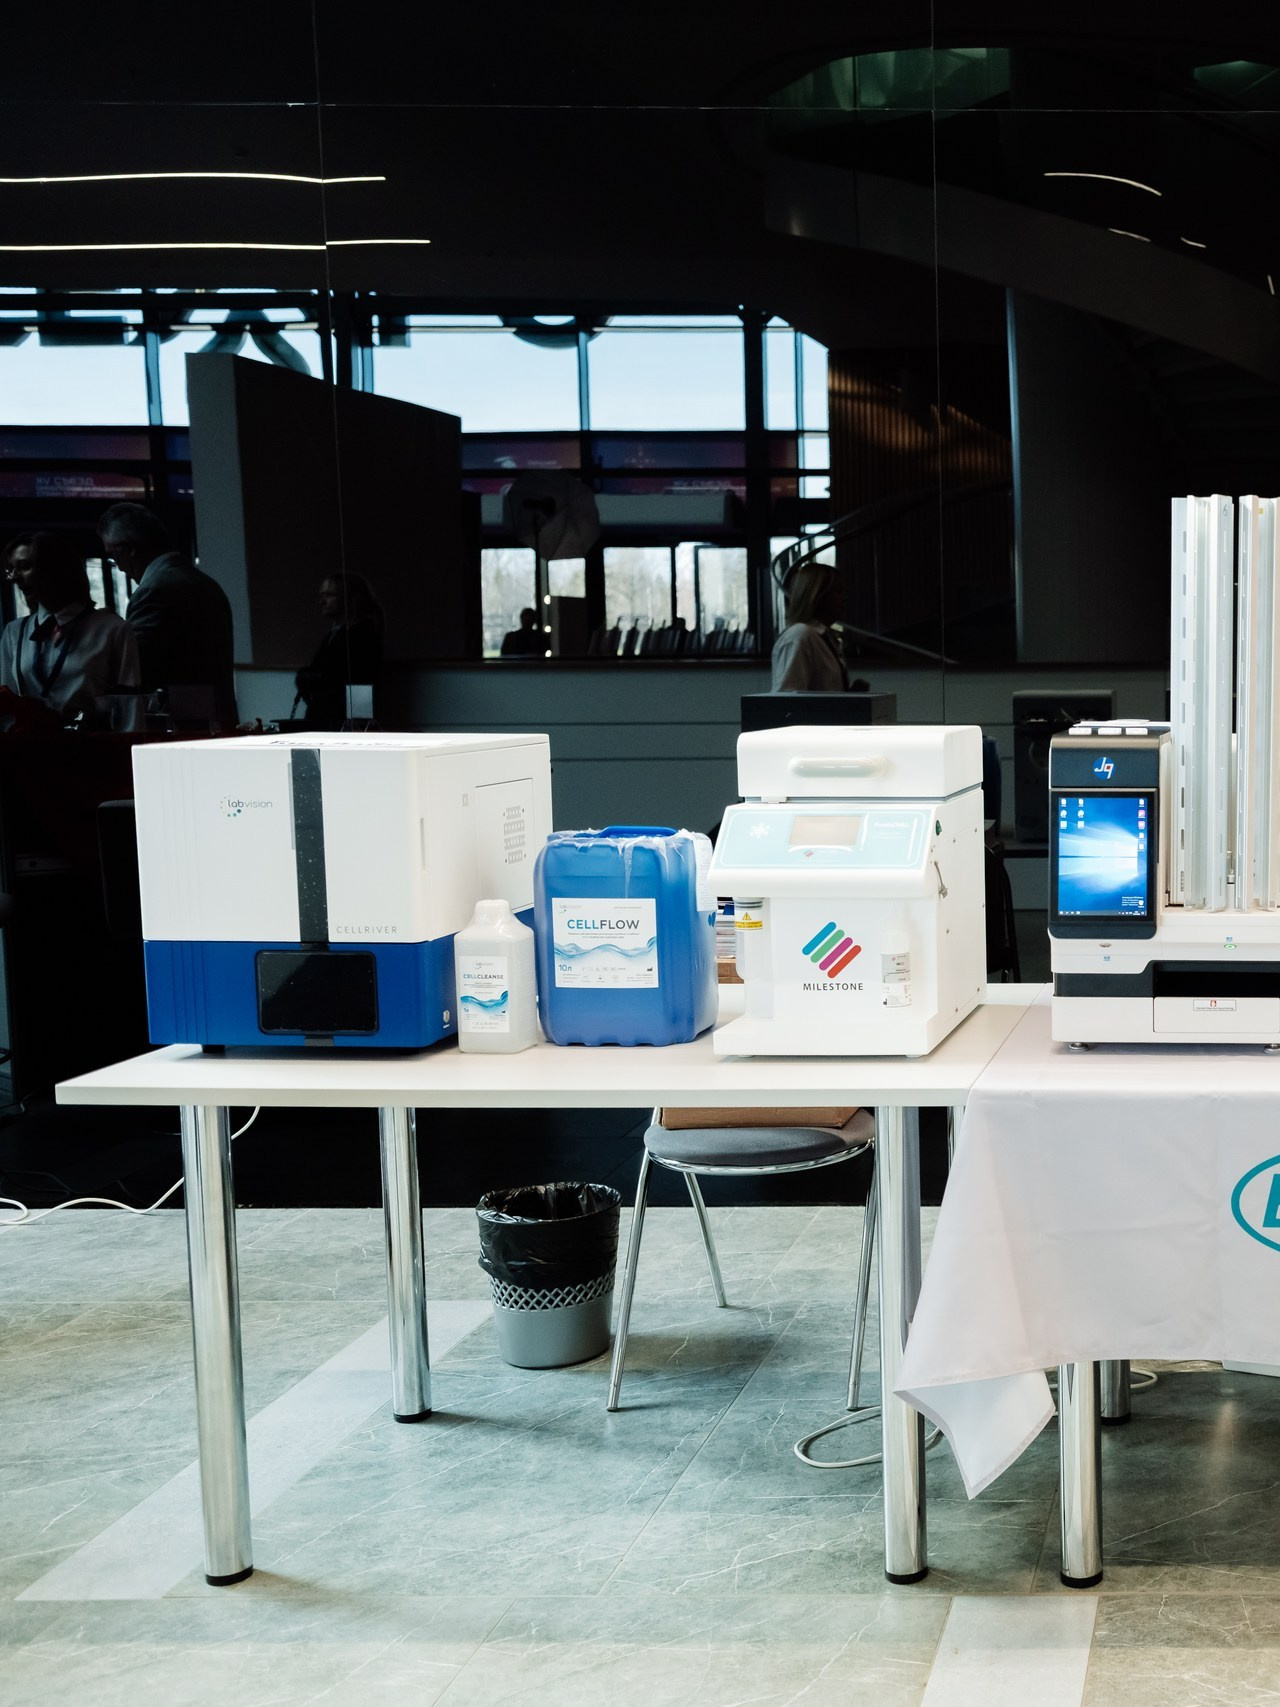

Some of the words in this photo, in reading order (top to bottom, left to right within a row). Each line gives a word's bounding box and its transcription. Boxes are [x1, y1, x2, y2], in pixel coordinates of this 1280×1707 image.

[227, 799, 273, 809] labvision
[567, 919, 640, 931] CELLFLOW
[336, 926, 397, 934] CELLRIVER
[803, 982, 864, 991] MILESTONE
